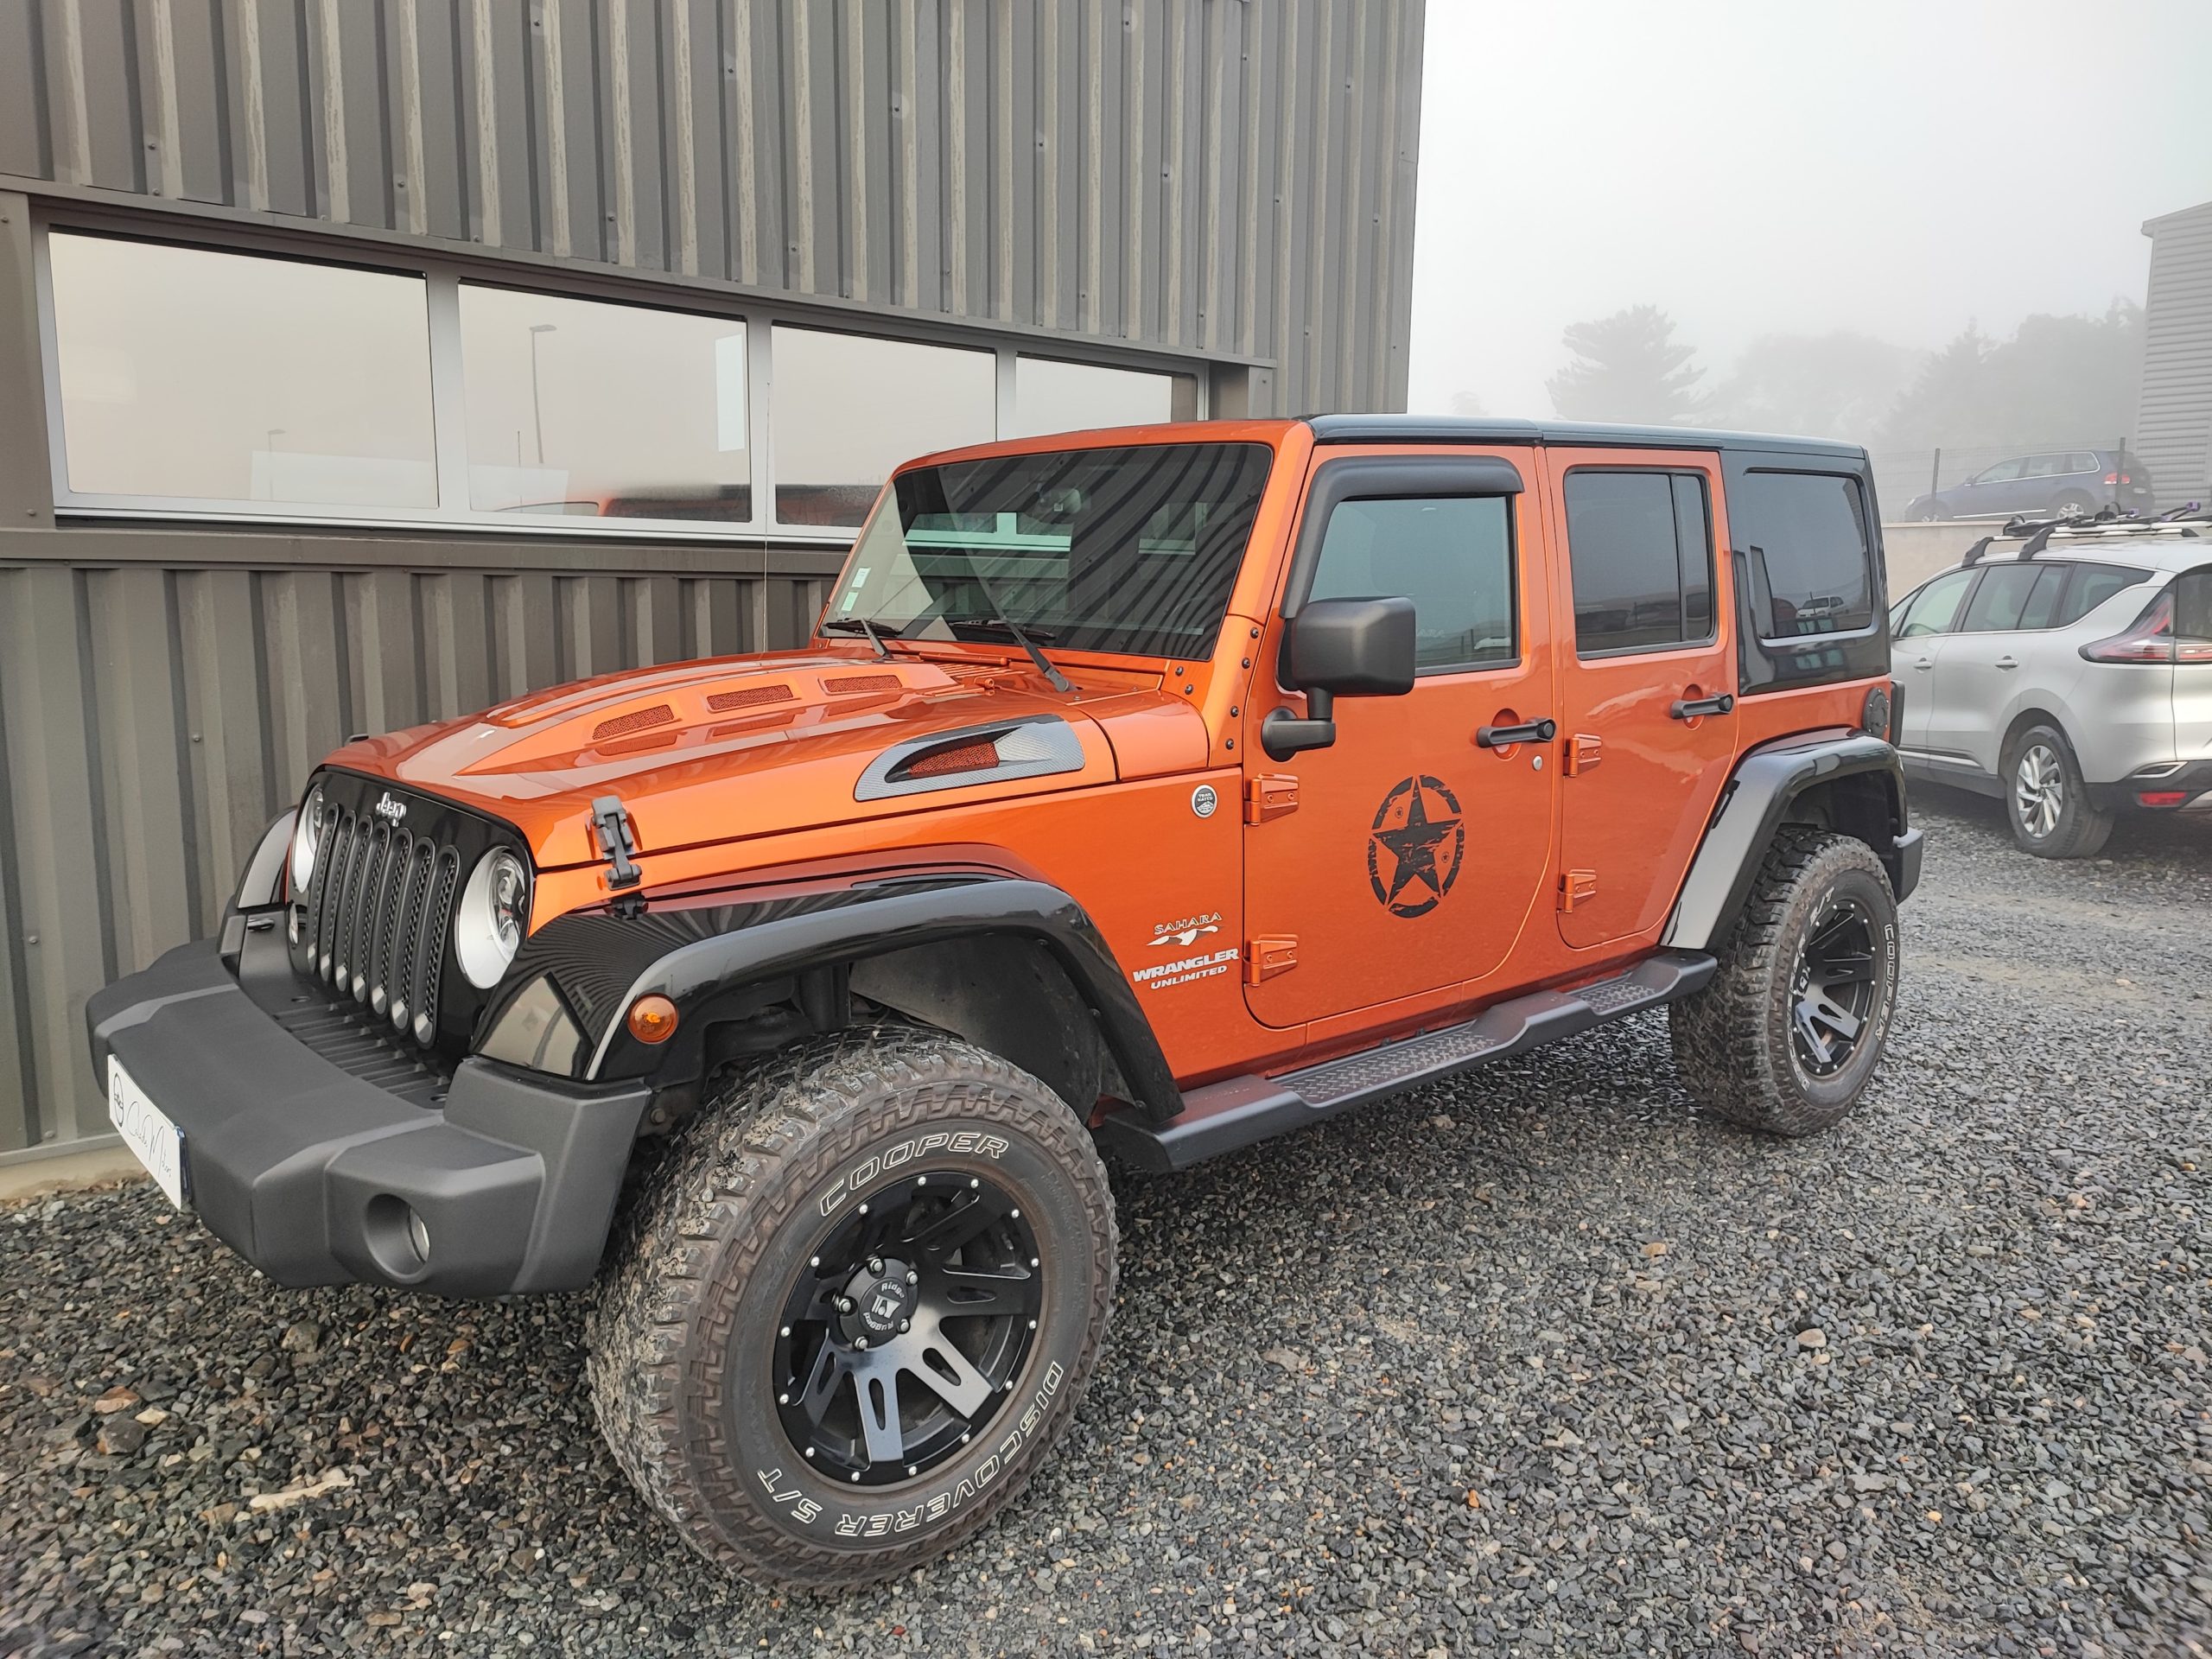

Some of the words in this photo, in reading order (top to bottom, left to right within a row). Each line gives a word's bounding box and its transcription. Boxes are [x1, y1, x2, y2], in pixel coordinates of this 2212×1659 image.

[376, 791, 406, 827] Jeep
[1154, 912, 1223, 936] SAHARA
[1133, 948, 1240, 982] WRANGLER
[1150, 965, 1228, 990] UNLIMITED
[1876, 924, 1896, 1041] COOPER
[820, 1132, 1009, 1217] COOPER
[880, 1281, 905, 1299] Ridge
[862, 1312, 894, 1332] Rugged
[834, 1360, 1065, 1537] DISCOVERER
[756, 1467, 823, 1524] S/T
